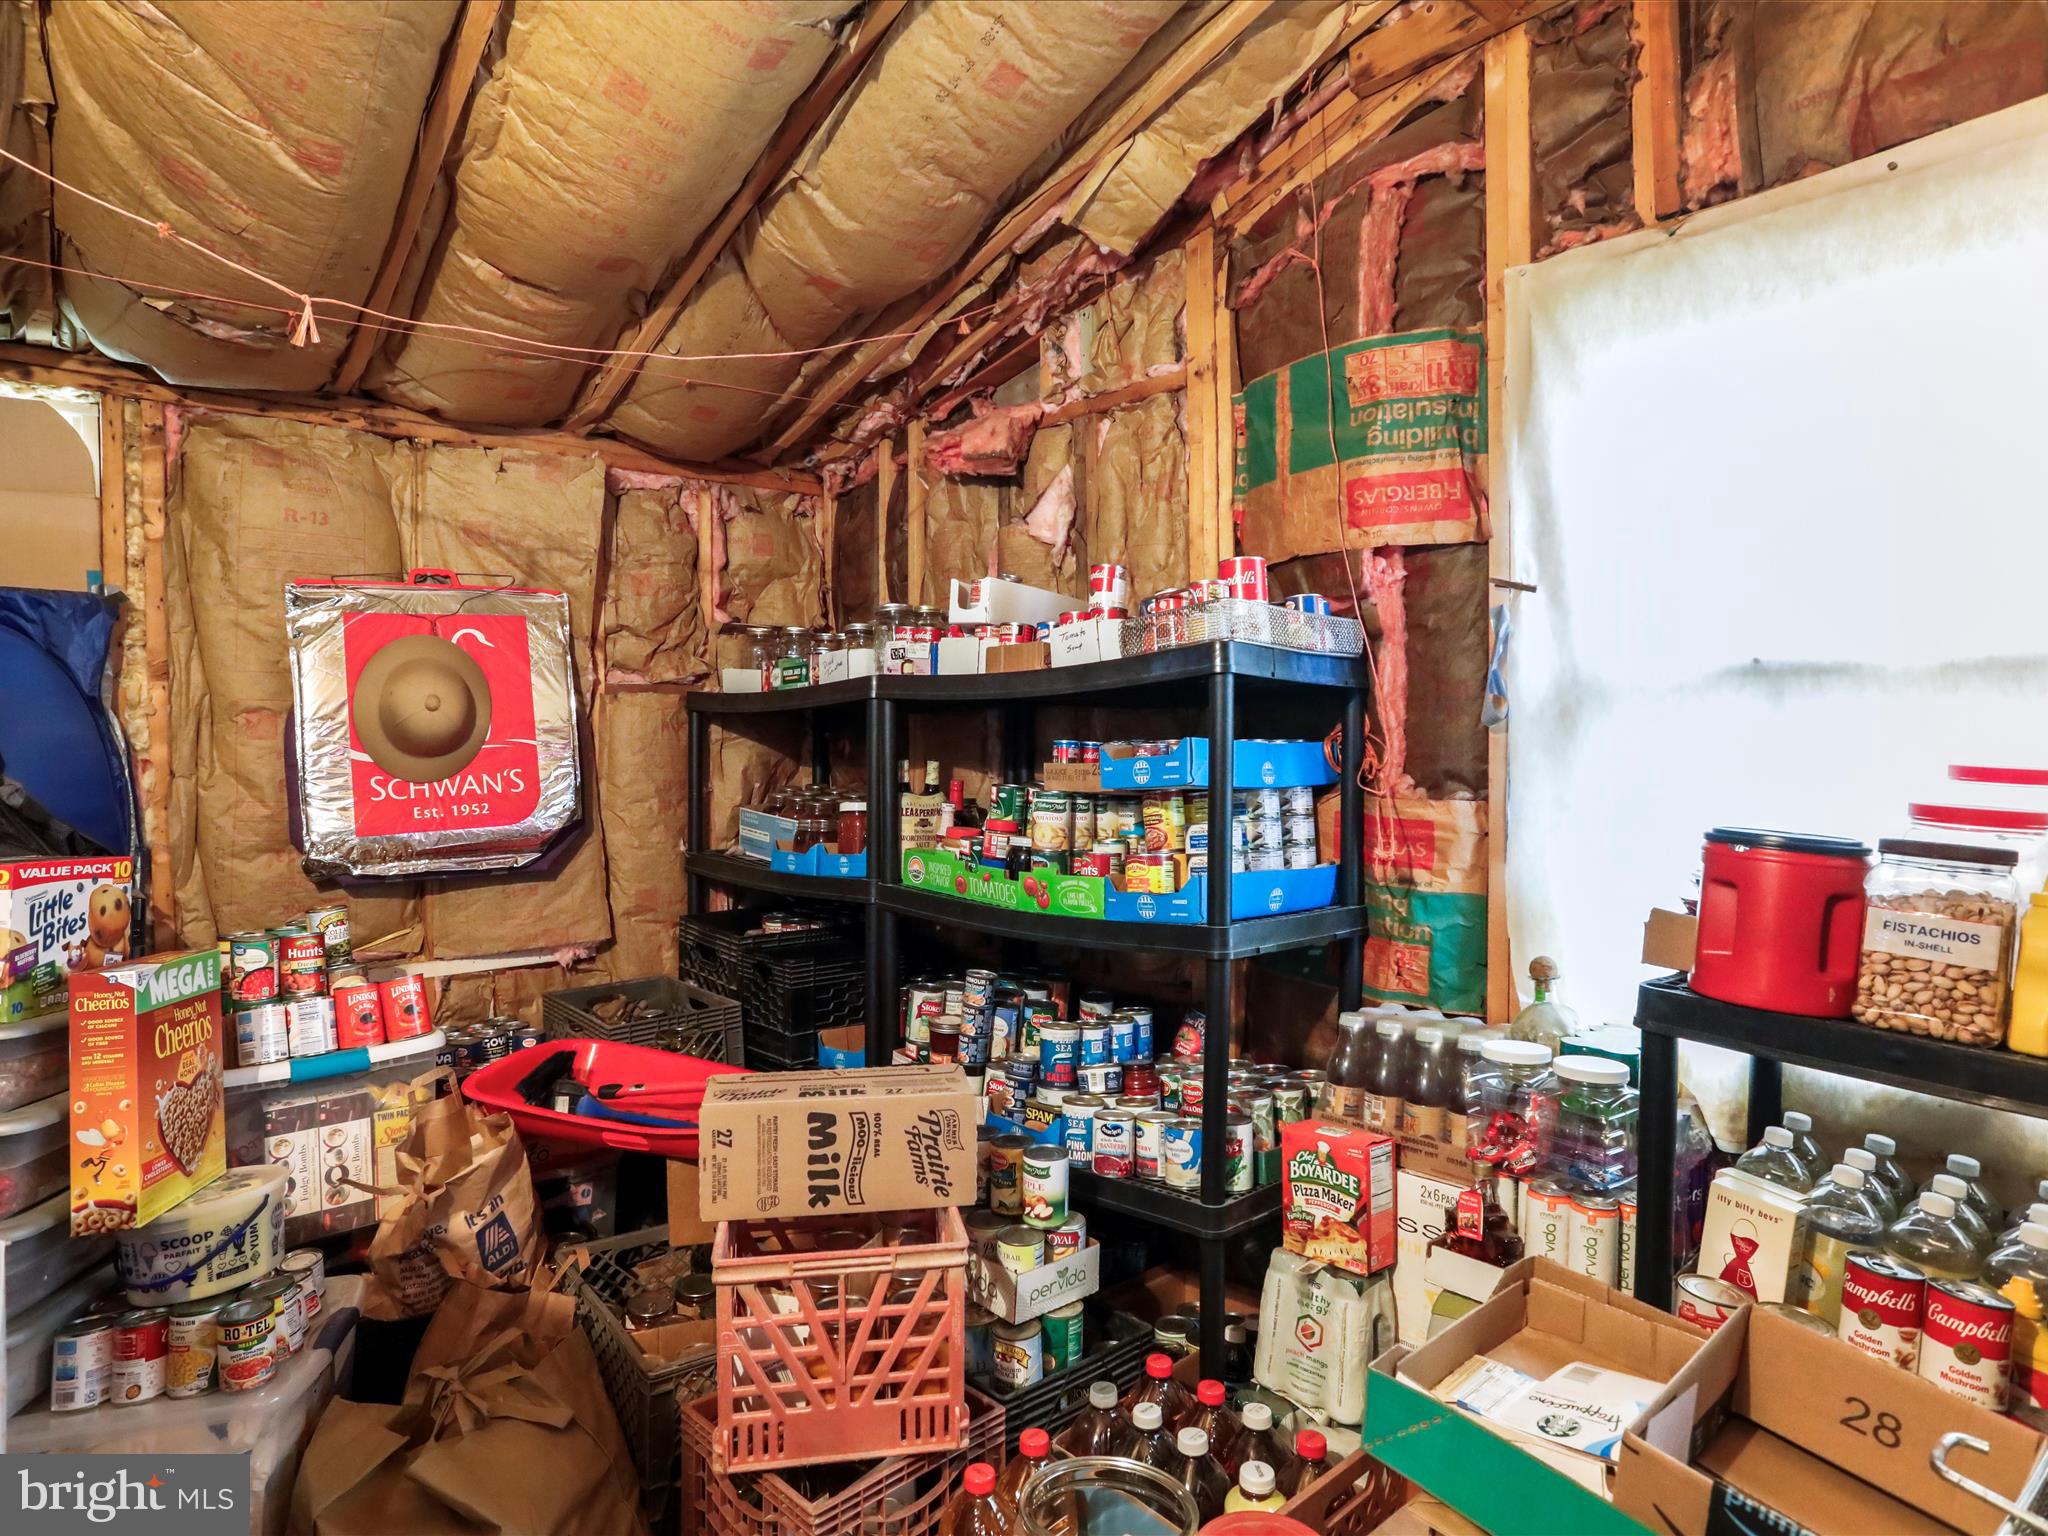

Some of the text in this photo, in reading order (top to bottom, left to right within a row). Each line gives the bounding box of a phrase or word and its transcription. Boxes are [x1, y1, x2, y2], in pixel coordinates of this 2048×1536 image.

[1353, 480, 1462, 506] FIBERGLAS
[282, 506, 330, 527] R-13
[1058, 627, 1086, 643] Tomato
[369, 768, 526, 802] SCHWAN'S
[412, 802, 490, 820] Est. 1952
[18, 860, 132, 880] VALUE PACK 10
[968, 876, 1017, 905] TOMATOES
[28, 888, 74, 938] Little
[42, 911, 87, 953] Bites
[1903, 939, 1954, 955] IN-SHELL
[93, 991, 113, 1000] Honey
[150, 961, 207, 1006] MEGA
[391, 981, 421, 998] LINDSAY
[11, 1001, 23, 1014] 10
[74, 997, 130, 1013] Cheerios
[347, 990, 378, 1007] LINDSAY
[174, 1000, 208, 1022] Honey Nut
[154, 1015, 213, 1060] Cheerios
[482, 1037, 506, 1048] GOY
[1055, 1044, 1073, 1052] SEA
[182, 1057, 196, 1070] REAL
[435, 1054, 452, 1063] YA
[376, 1107, 410, 1122] TWIN PAC
[1026, 1107, 1054, 1124] SPAM
[1067, 1119, 1086, 1129] SEA
[716, 1128, 733, 1149] 27
[873, 1112, 882, 1158] 100% REAL
[944, 1115, 952, 1145] OWNED
[949, 1113, 959, 1146] FARMER
[352, 1133, 361, 1162] Bombs
[903, 1125, 929, 1186] Farms
[917, 1109, 953, 1198] Prairie
[1066, 1139, 1086, 1151] PINK
[1068, 1150, 1092, 1162] LMON
[1295, 1151, 1316, 1163] Chef
[299, 1143, 308, 1173] Bombs
[806, 1111, 841, 1209] Milk
[847, 1116, 868, 1200] MOO-licious
[1023, 1180, 1045, 1191] PPLE
[1289, 1160, 1360, 1196] BOYARDEE
[1293, 1184, 1355, 1212] Pizza Maker
[1717, 1193, 1732, 1206] itty
[1735, 1200, 1754, 1215] bitty
[1757, 1208, 1779, 1224] bevs
[463, 1194, 505, 1230] It's an
[160, 1230, 214, 1251] SCOOP
[249, 1222, 259, 1251] YUM
[1048, 1233, 1075, 1245] OYAL
[163, 1247, 201, 1260] PARFAIT
[486, 1240, 515, 1267] ALDI
[1584, 1237, 1598, 1277] rvida
[1029, 1268, 1087, 1307] pervida
[1843, 1272, 1916, 1312] Campbell's
[1847, 1334, 1891, 1359] Mushroom
[1853, 1329, 1883, 1347] Golden
[1939, 1370, 1990, 1394] Mushroom
[1948, 1365, 1983, 1383] Golden
[1528, 1394, 1623, 1433] frappuccino
[1839, 1395, 1903, 1450] 28
